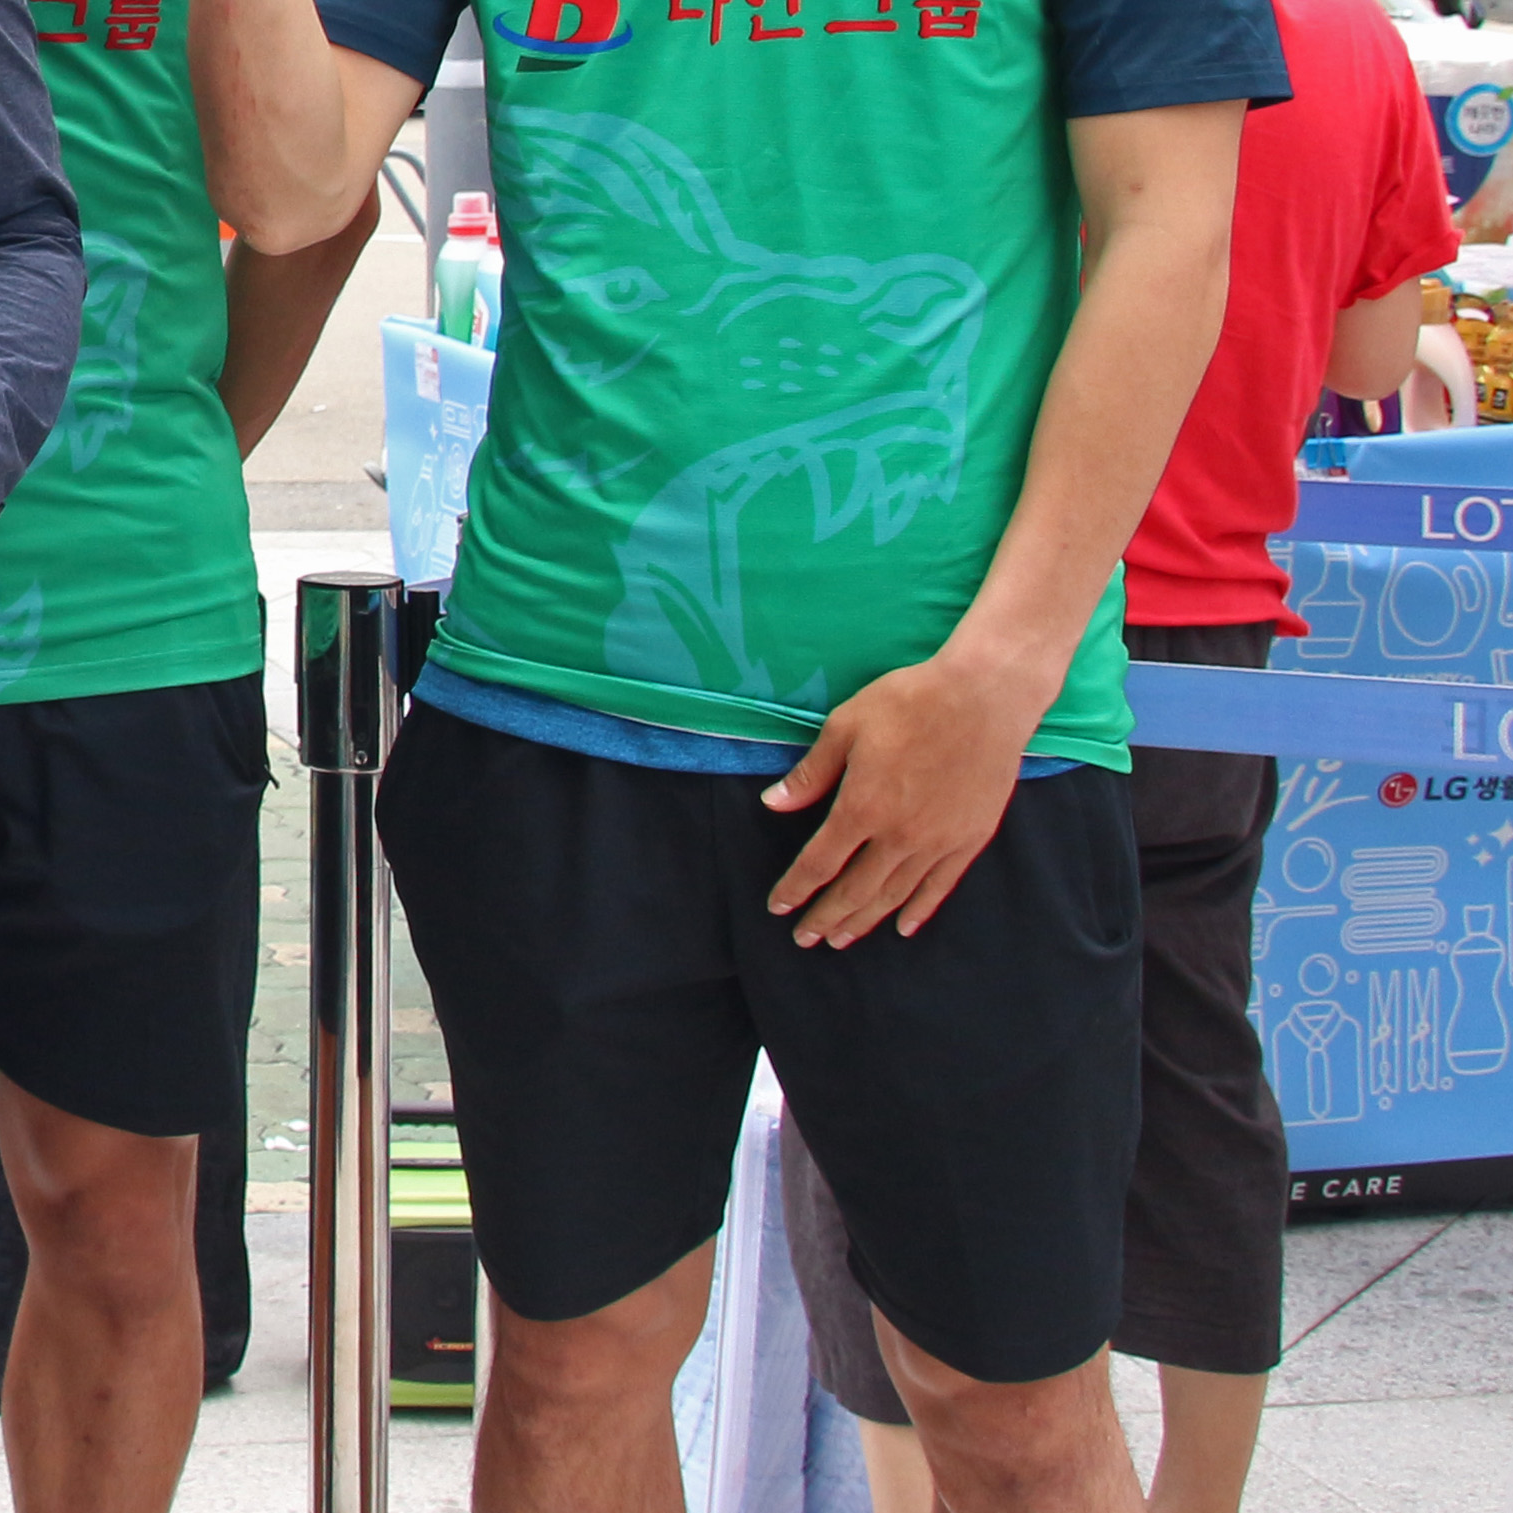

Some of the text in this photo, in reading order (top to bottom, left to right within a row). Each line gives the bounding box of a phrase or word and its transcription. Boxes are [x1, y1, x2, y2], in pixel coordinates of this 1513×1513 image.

[1421, 495, 1513, 543] LO
[1422, 776, 1469, 801] LG
[1322, 1175, 1403, 1198] CARE
